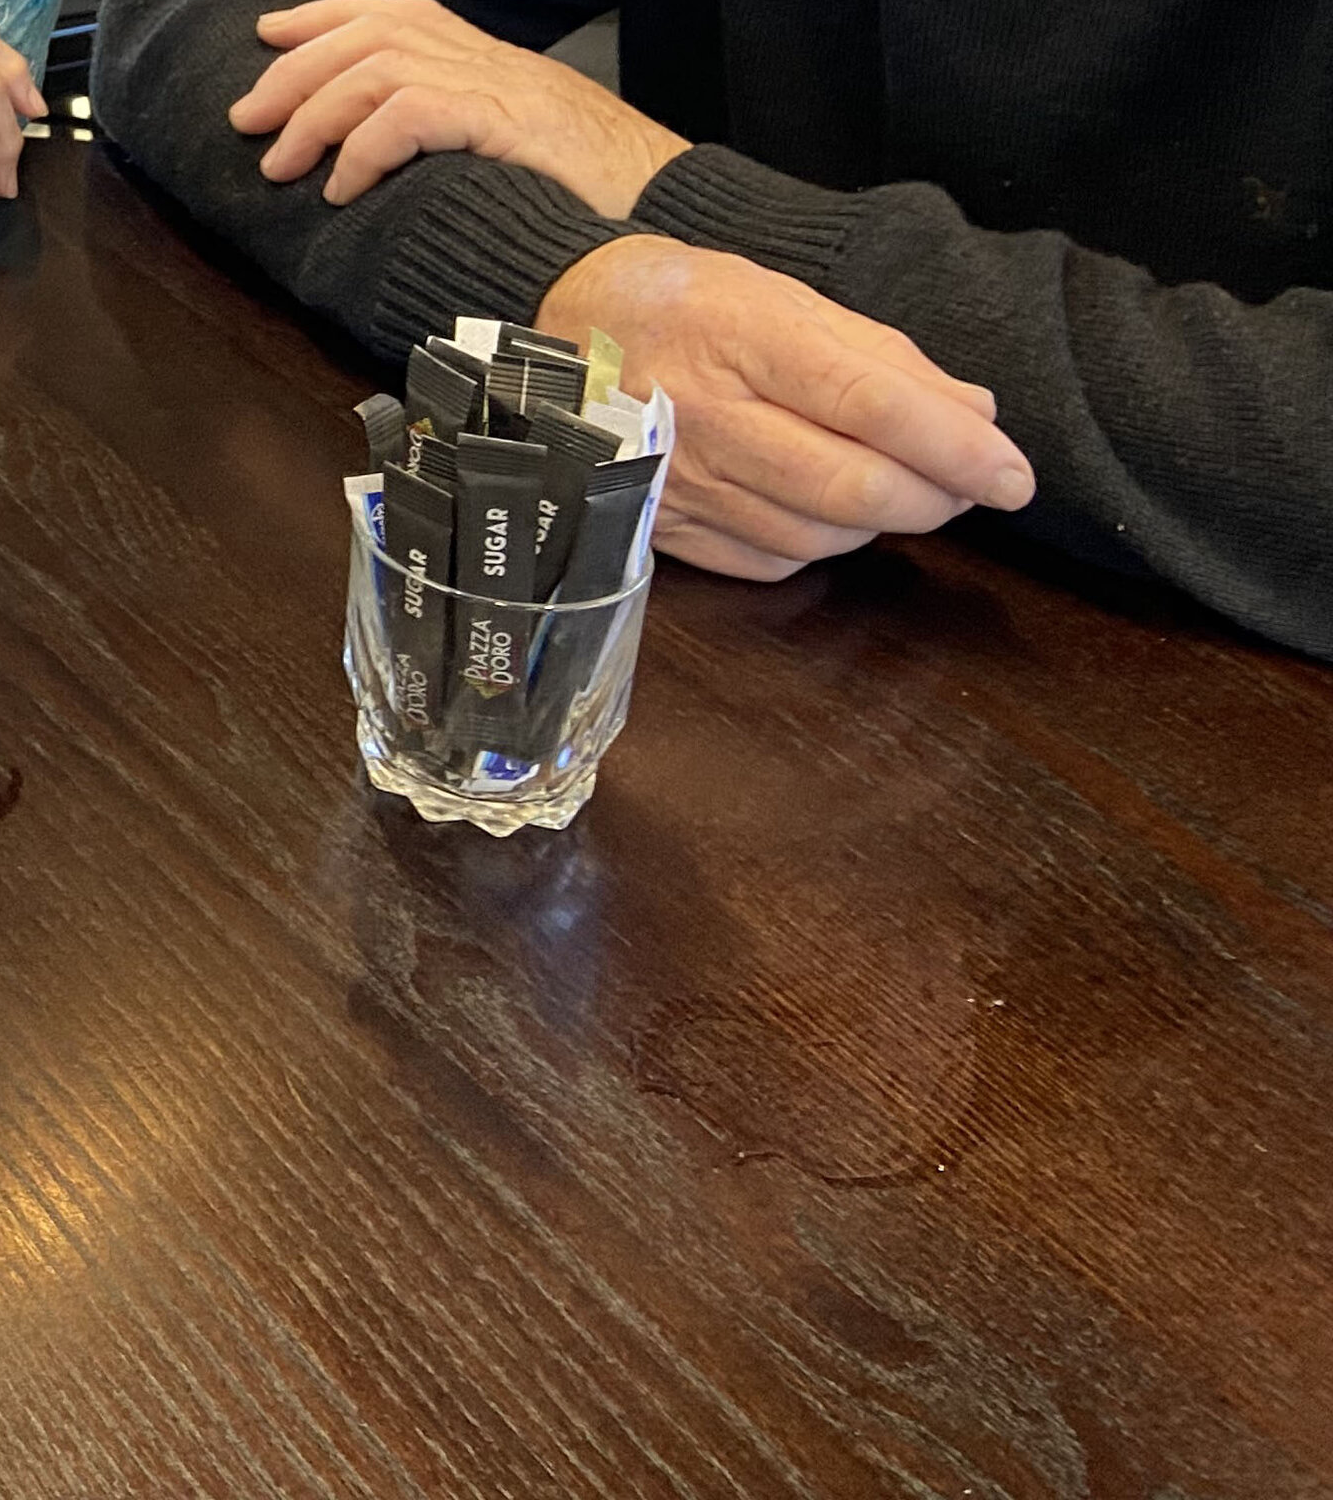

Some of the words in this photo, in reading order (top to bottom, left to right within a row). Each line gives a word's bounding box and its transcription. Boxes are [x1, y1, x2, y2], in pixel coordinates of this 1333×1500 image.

[483, 508, 509, 577] SUGAR
[404, 548, 428, 619] SUGAR
[463, 619, 492, 681] PIAZZA
